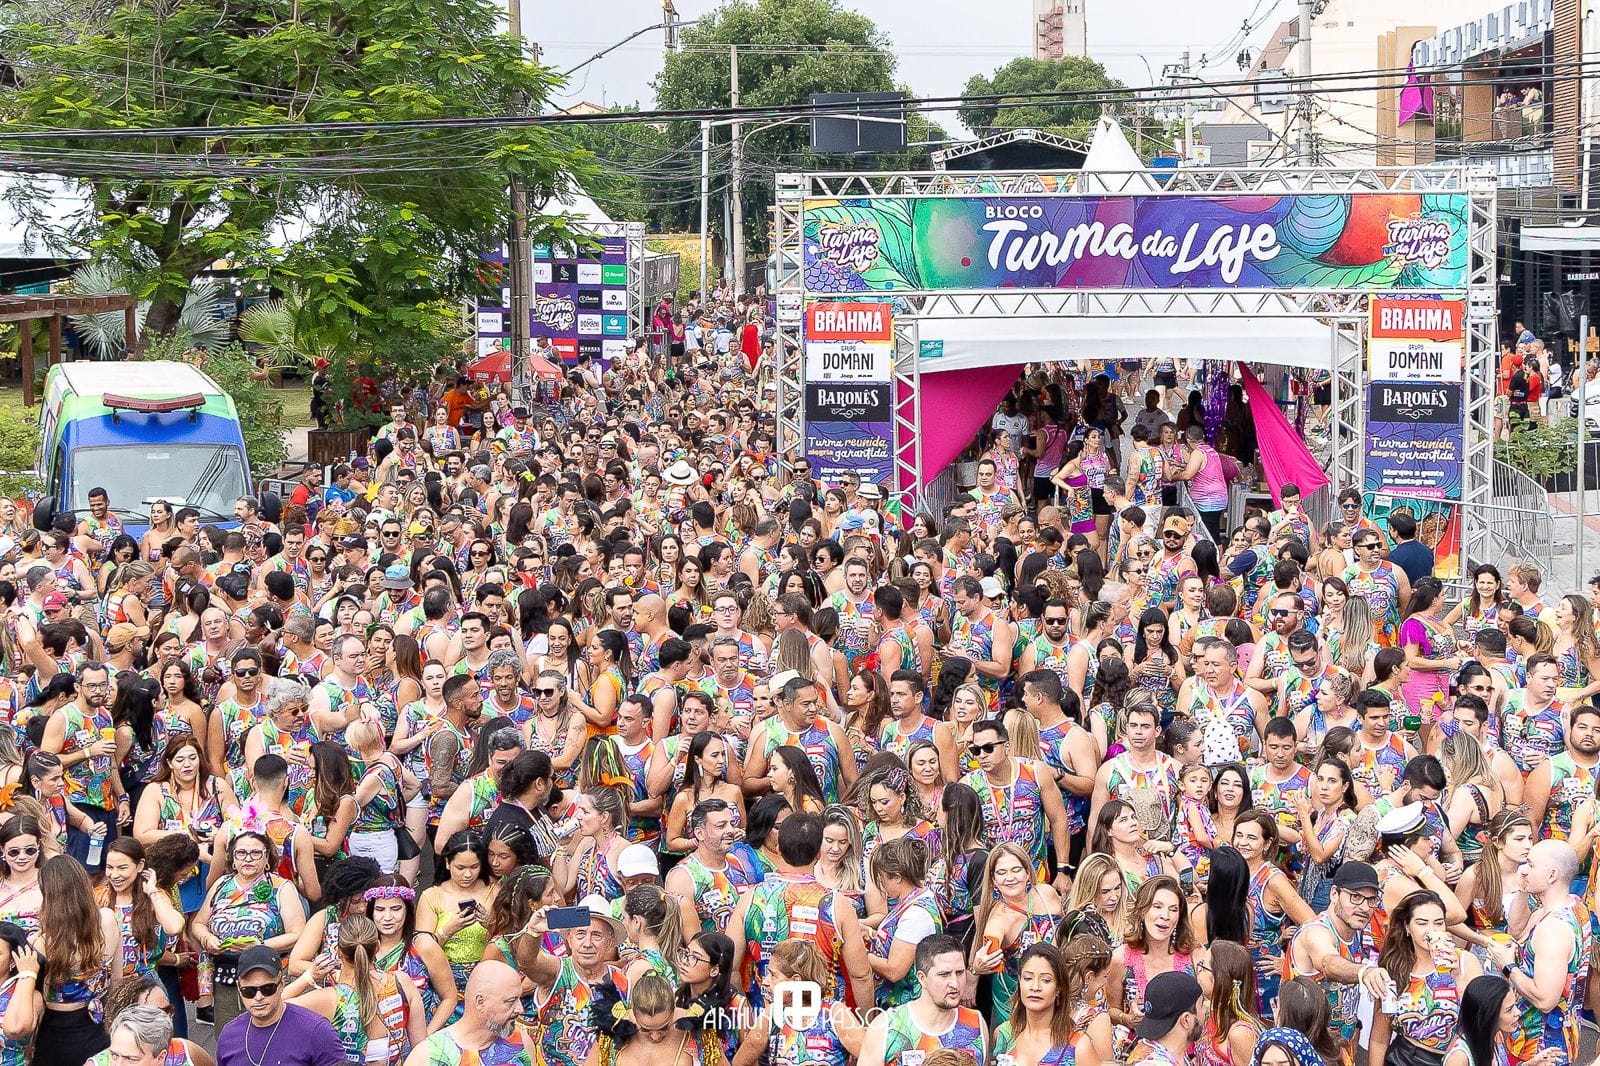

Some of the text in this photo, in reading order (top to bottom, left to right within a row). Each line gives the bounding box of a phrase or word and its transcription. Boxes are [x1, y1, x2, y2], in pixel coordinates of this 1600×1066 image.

[985, 205, 1043, 219] BLOCO
[820, 228, 878, 248] Turma
[1389, 222, 1449, 242] Turma
[827, 244, 878, 270] da Laje
[982, 219, 1282, 284] Turma da Laje
[1396, 239, 1449, 266] da Laje
[537, 301, 573, 313] Turma
[547, 311, 573, 329] Laje
[814, 310, 883, 333] BRAHMA
[1381, 307, 1453, 331] BRAHMA
[823, 353, 874, 370] DOMANI
[1389, 351, 1443, 369] DOMANI
[817, 388, 879, 407] BARONÊS
[1383, 388, 1448, 407] BARONÊS
[807, 435, 888, 449] Turma reunida,
[1370, 436, 1456, 451] Turma reunida,
[832, 446, 889, 462] garantida
[1396, 449, 1456, 464] garantida
[820, 467, 850, 475] Marqu
[213, 918, 261, 933] Turma
